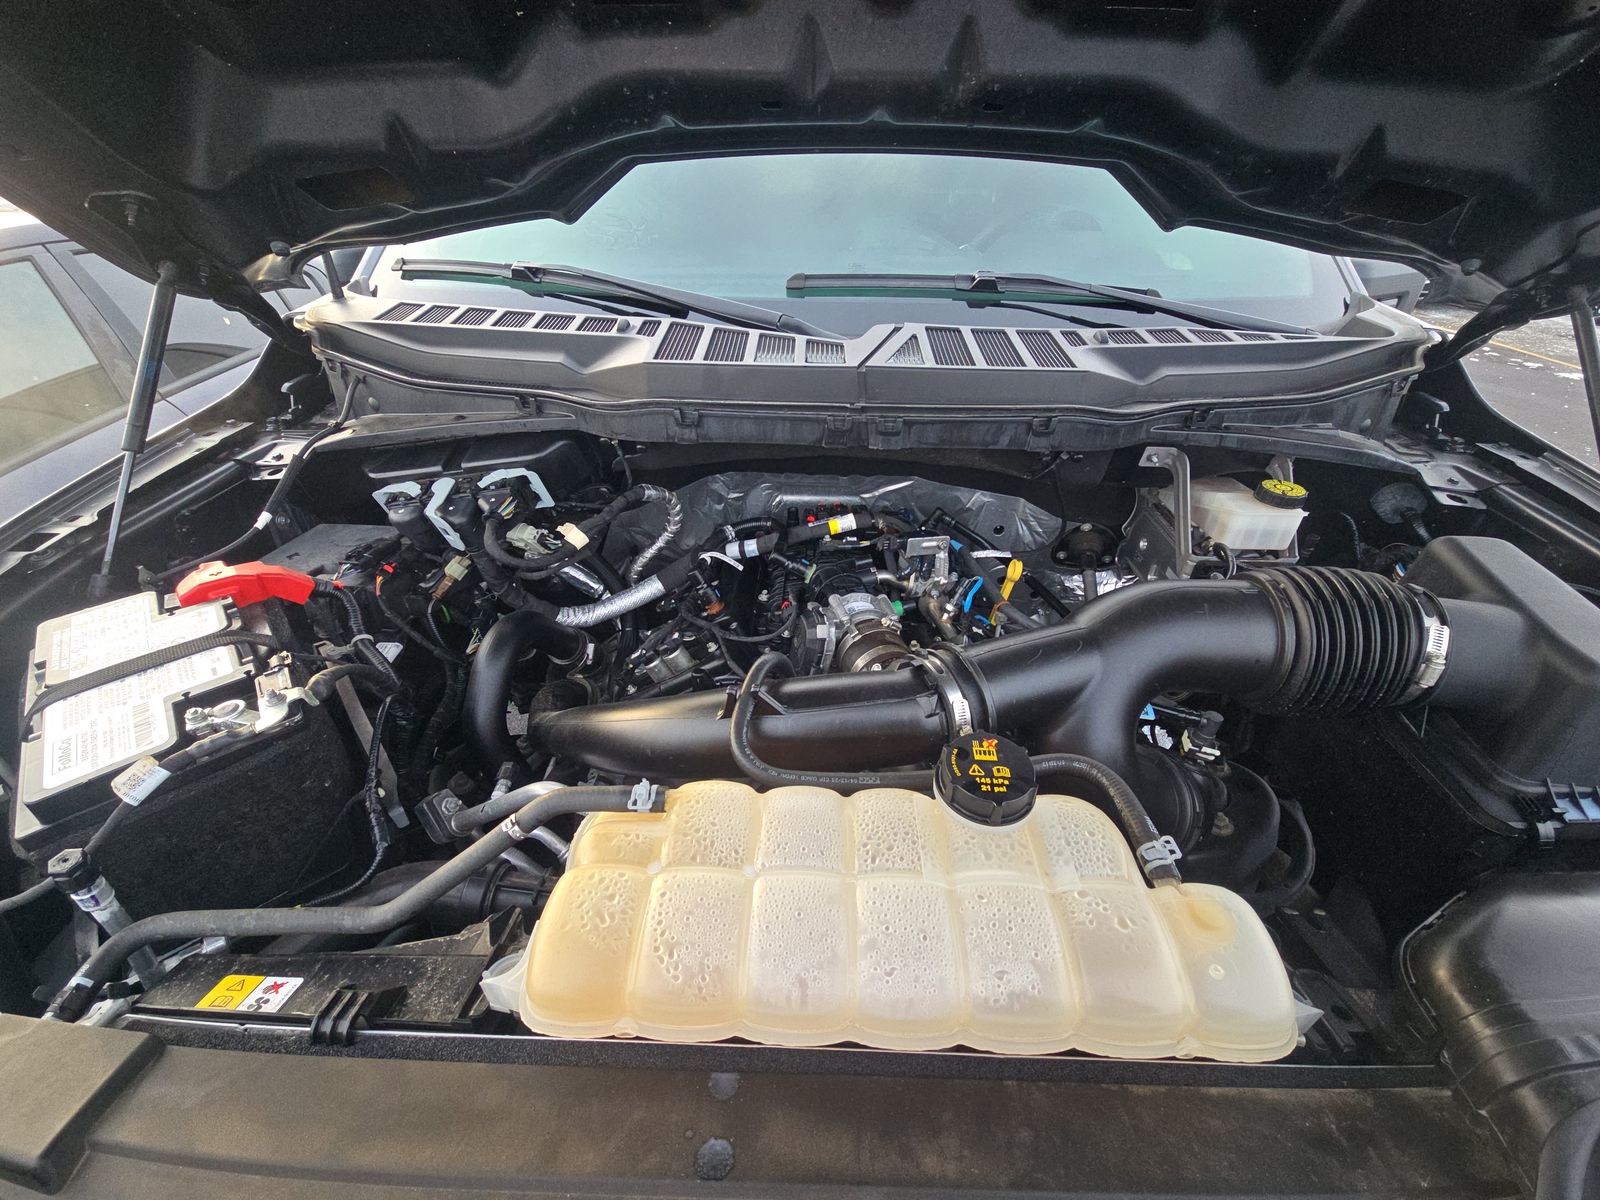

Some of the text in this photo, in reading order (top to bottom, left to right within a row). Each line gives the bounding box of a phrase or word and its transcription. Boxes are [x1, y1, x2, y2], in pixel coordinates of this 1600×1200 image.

[58, 737, 72, 771] FoMoCo
[993, 777, 1010, 785] kPa
[980, 784, 1007, 793] 21 psi
